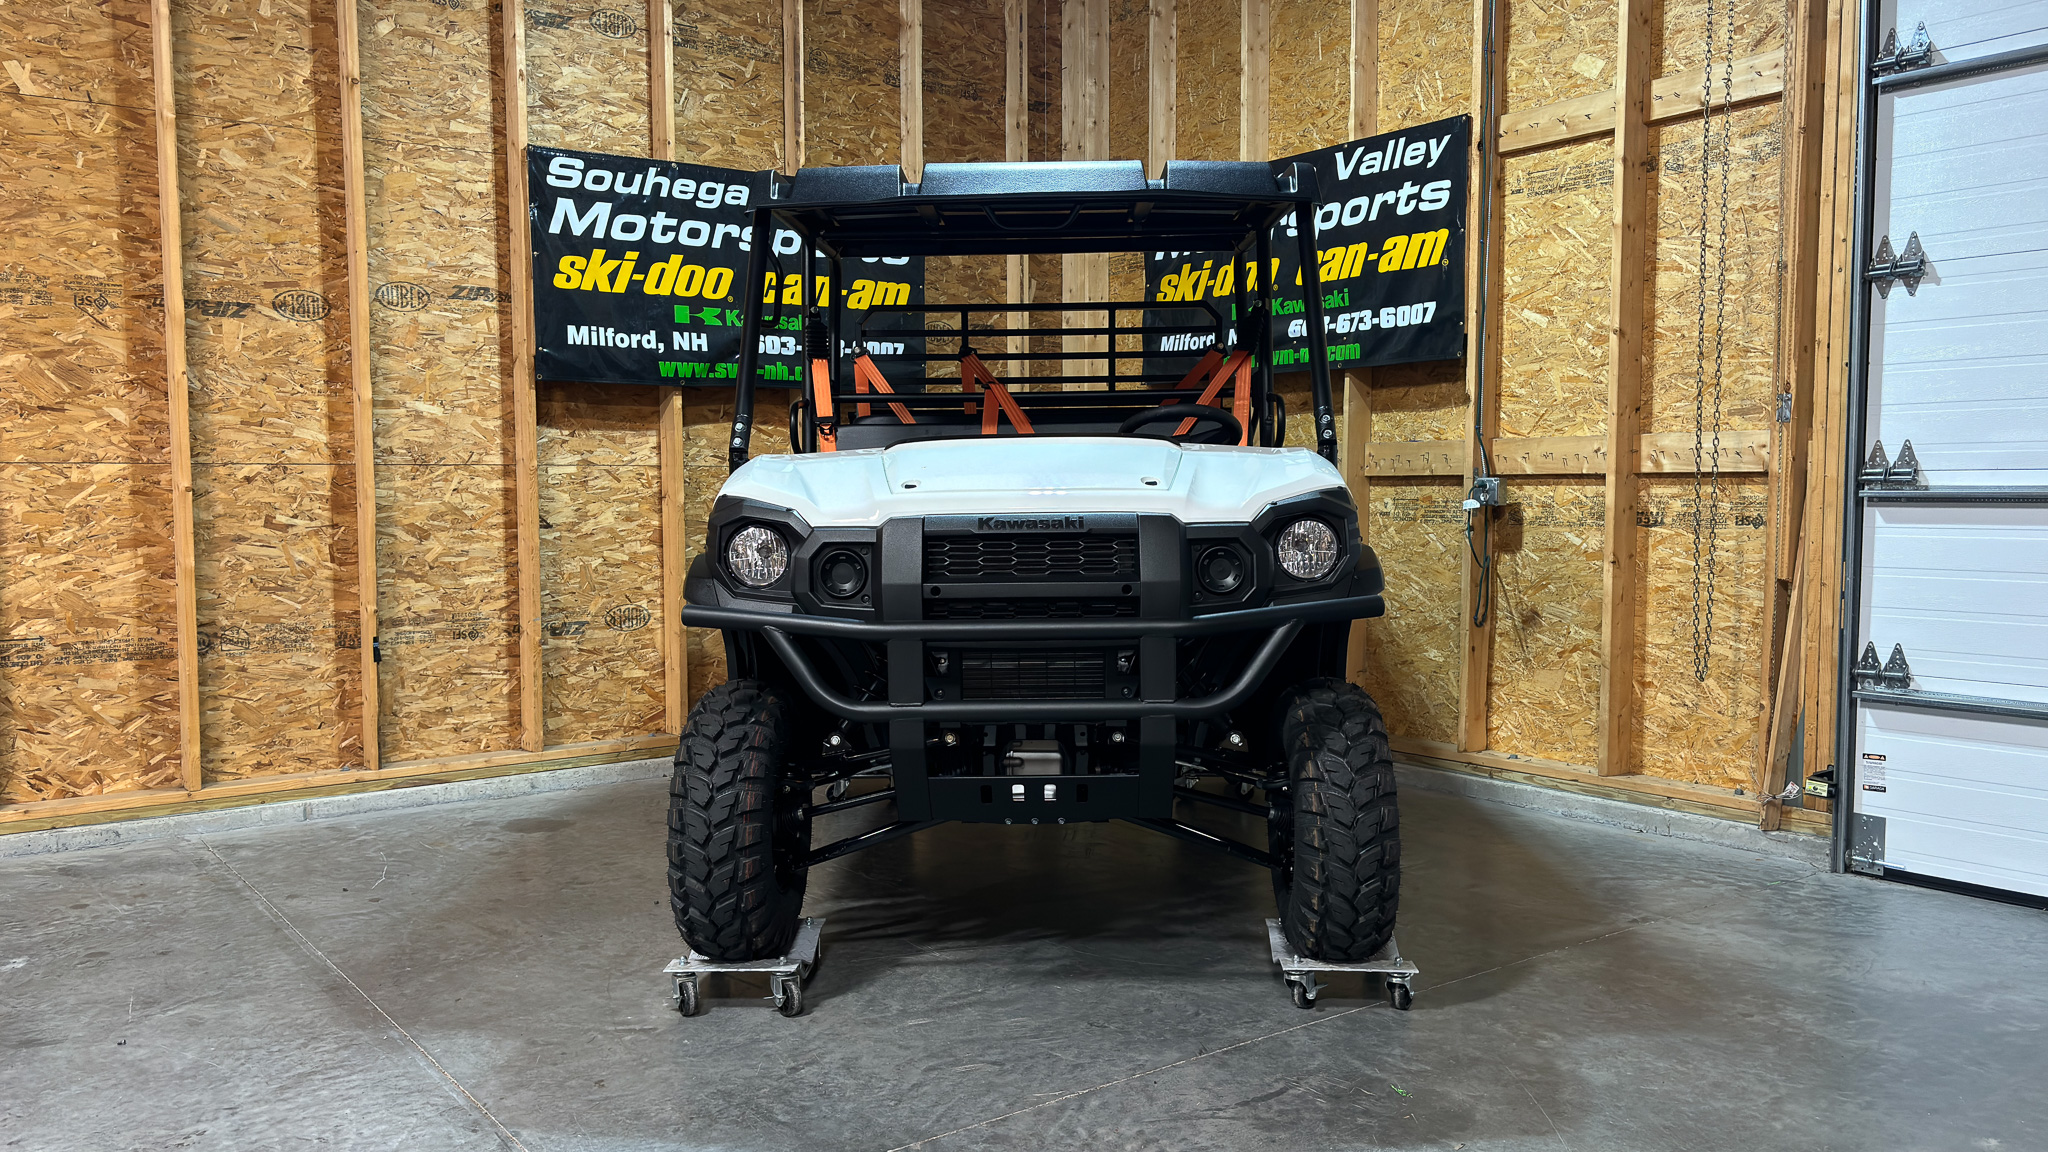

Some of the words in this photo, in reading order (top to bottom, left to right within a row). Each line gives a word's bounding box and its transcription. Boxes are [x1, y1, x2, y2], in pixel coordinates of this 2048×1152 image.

[1334, 133, 1452, 181] Valley
[546, 156, 750, 209] Souhega
[566, 324, 665, 354] Milford,
[672, 331, 708, 352] NH
[977, 515, 1085, 531] Kawasaki
